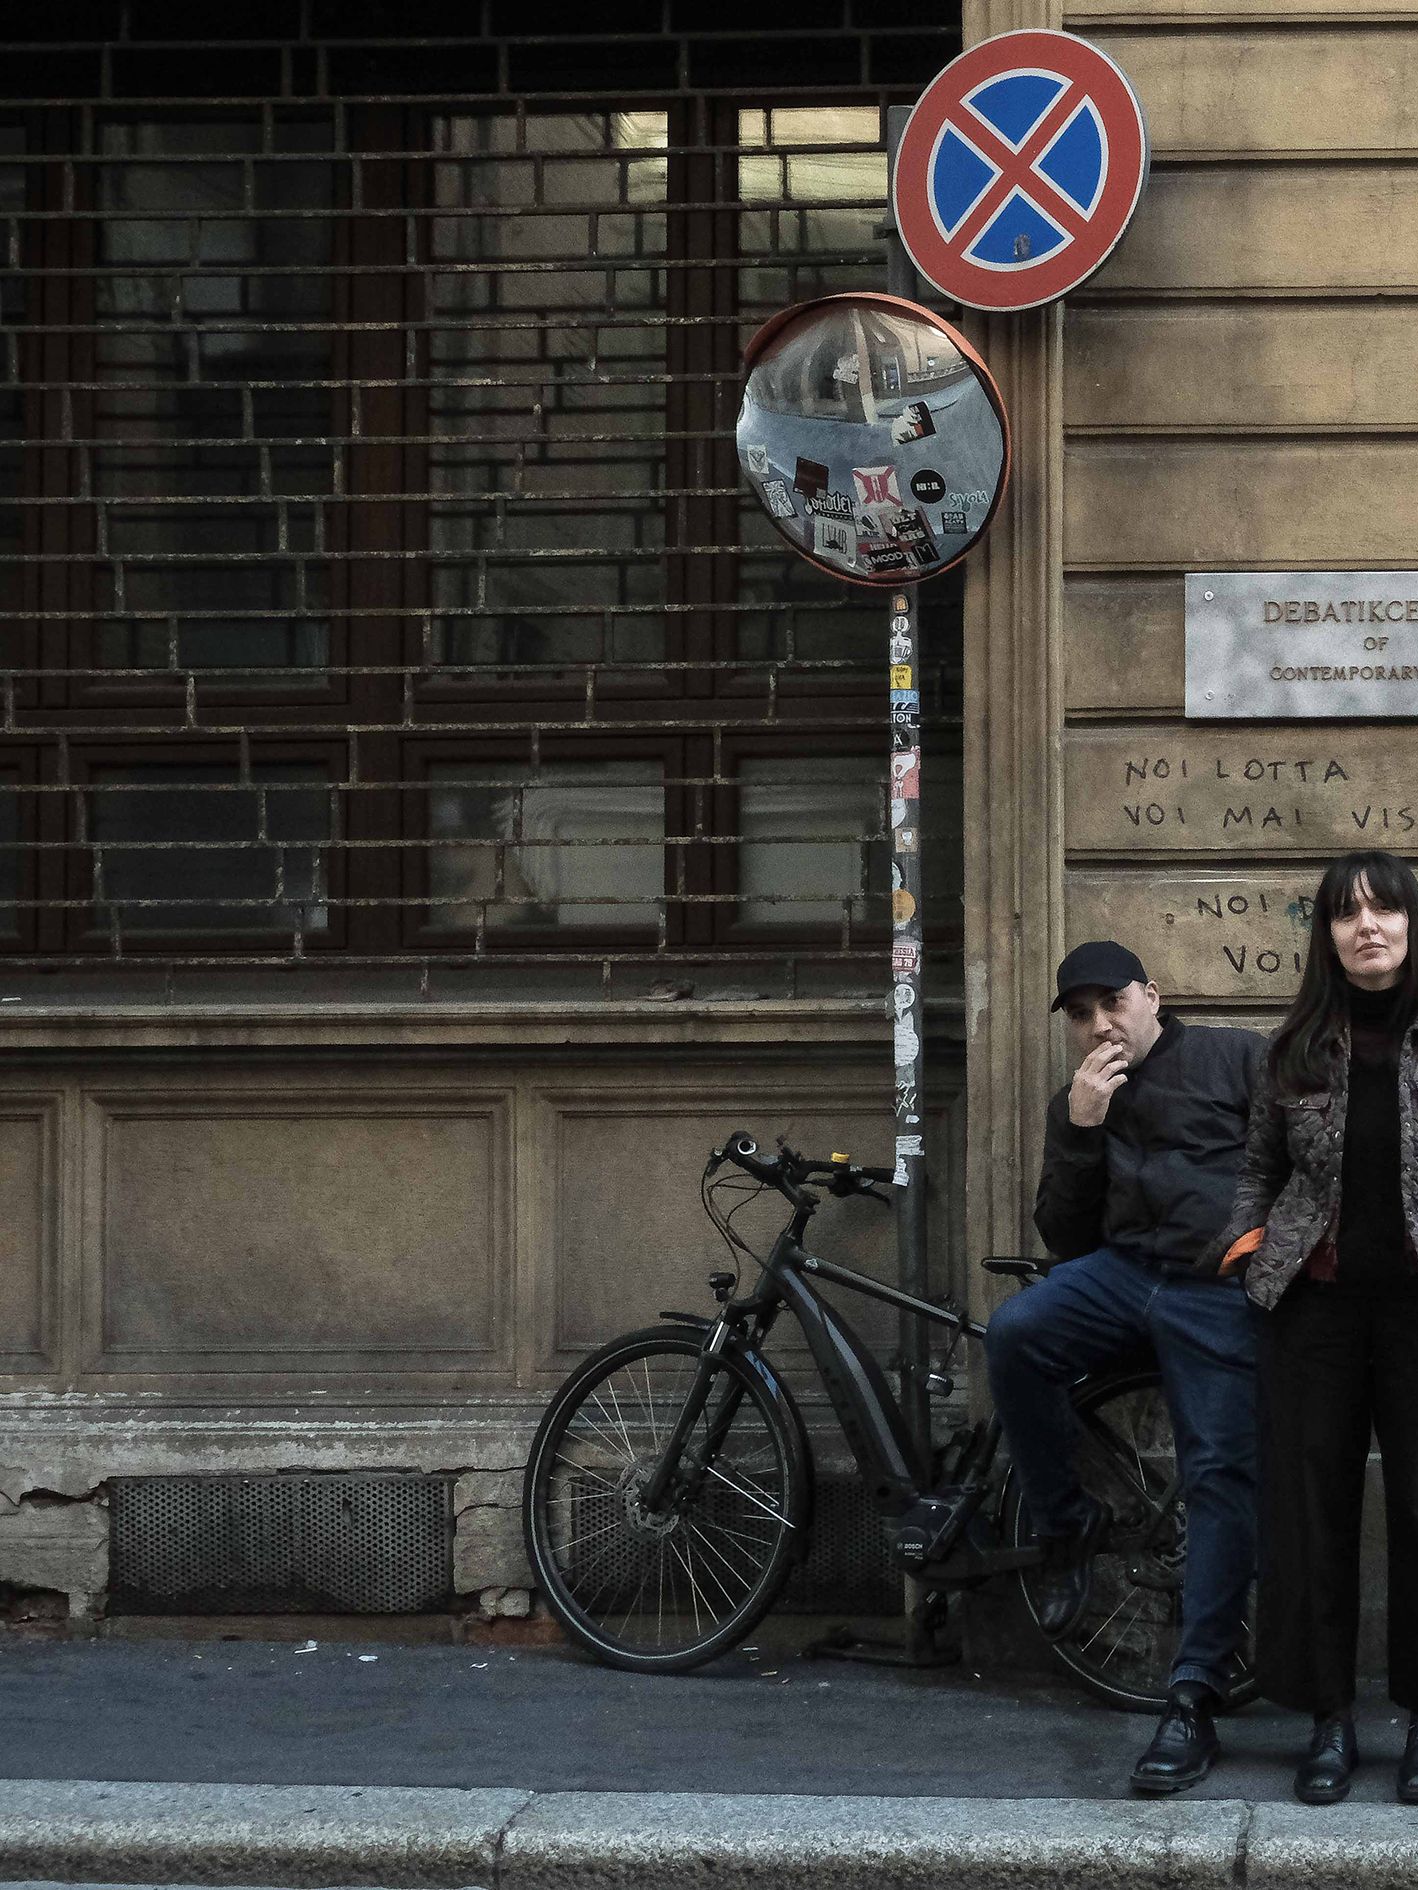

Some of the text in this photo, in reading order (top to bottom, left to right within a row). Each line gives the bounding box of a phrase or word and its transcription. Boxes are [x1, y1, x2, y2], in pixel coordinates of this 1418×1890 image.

[871, 551, 903, 564] MOOD
[1364, 635, 1388, 652] OF
[1125, 759, 1348, 786] NOI LOTTA
[1123, 804, 1184, 827] VOI
[1223, 806, 1301, 830] MAI
[1197, 894, 1269, 920] NOI
[1223, 945, 1301, 974] VOI
